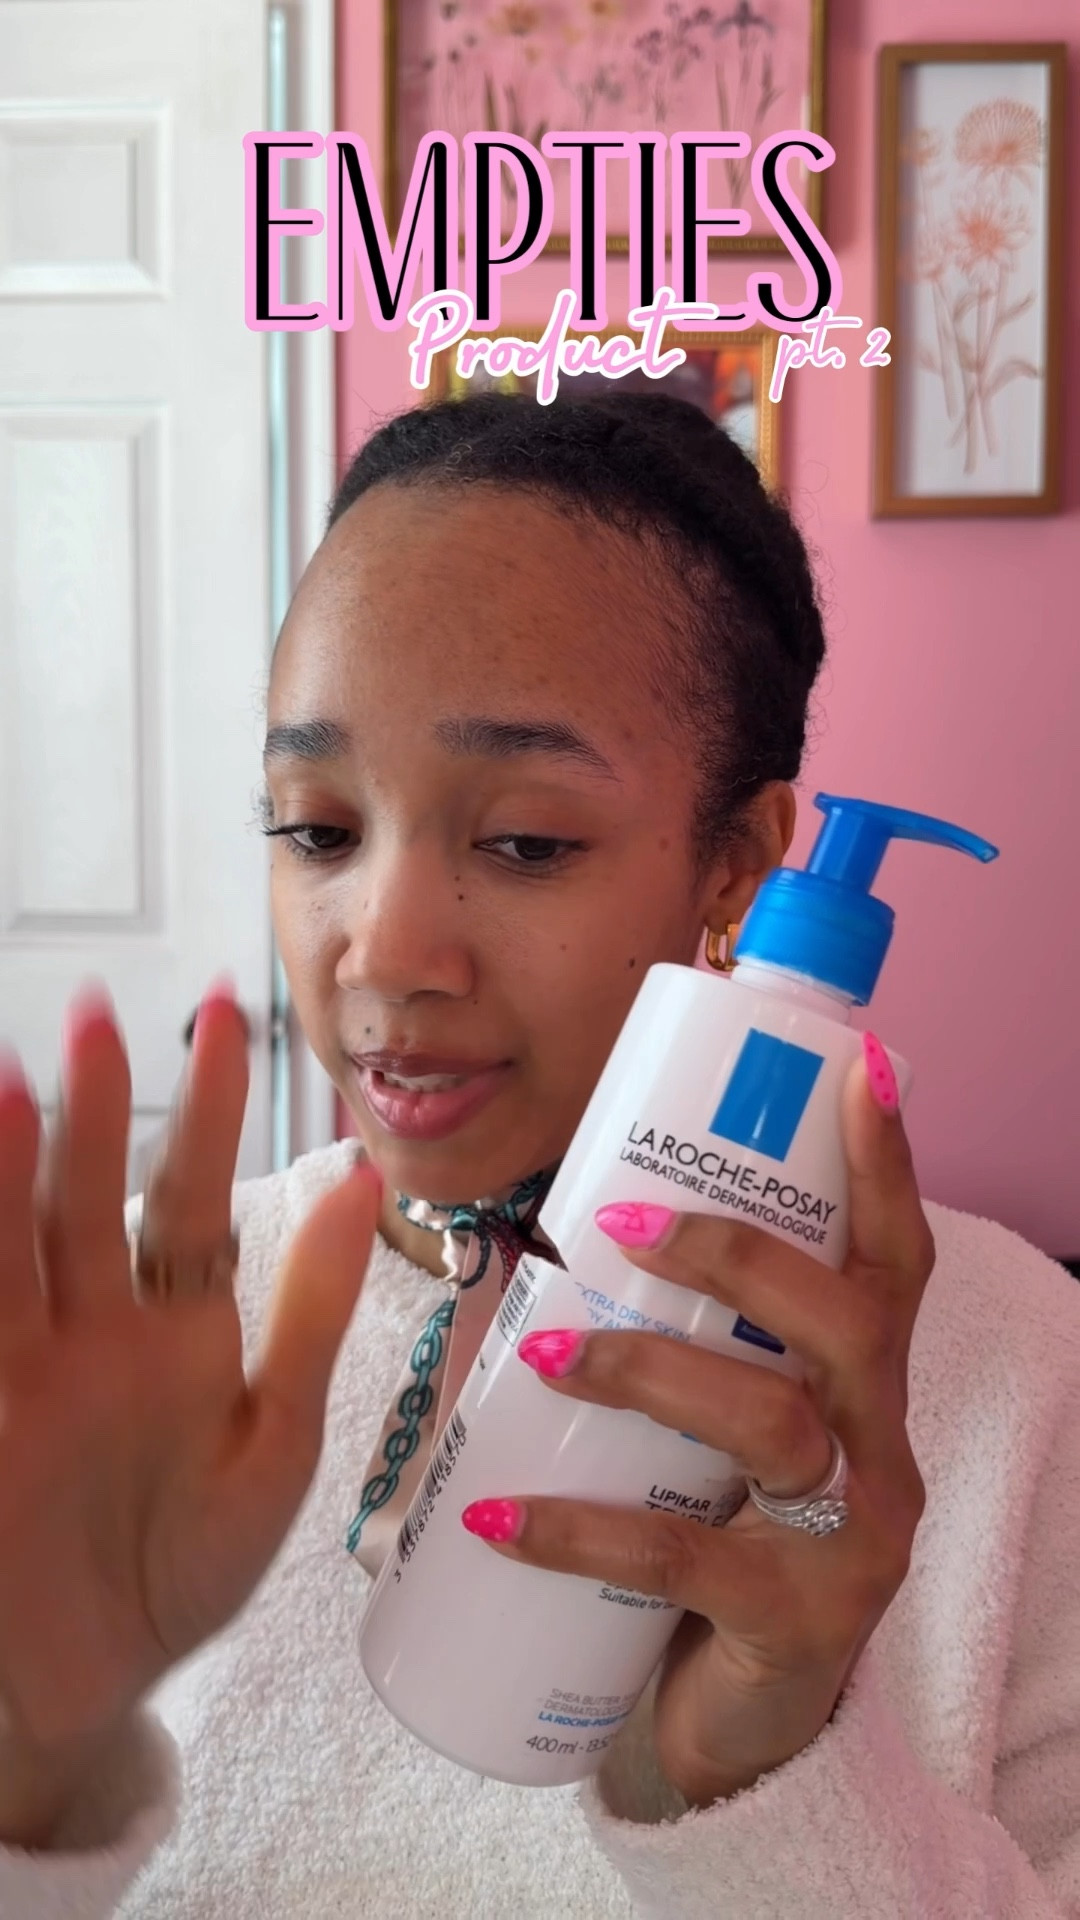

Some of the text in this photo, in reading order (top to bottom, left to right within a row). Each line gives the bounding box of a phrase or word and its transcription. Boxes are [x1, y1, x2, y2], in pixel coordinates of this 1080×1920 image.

[626, 1120, 838, 1226] LA ROCHE-POSAY
[620, 1147, 829, 1246] LABORATOIRE DERMATOLOGIQUE
[574, 1281, 617, 1315] XTRA
[617, 1305, 652, 1328] DRY
[649, 1485, 711, 1513] LIPIKAR
[598, 1587, 648, 1610] Suitable
[550, 1688, 581, 1703] SHEA
[538, 1711, 553, 1722] LA
[526, 1735, 560, 1754] 400
